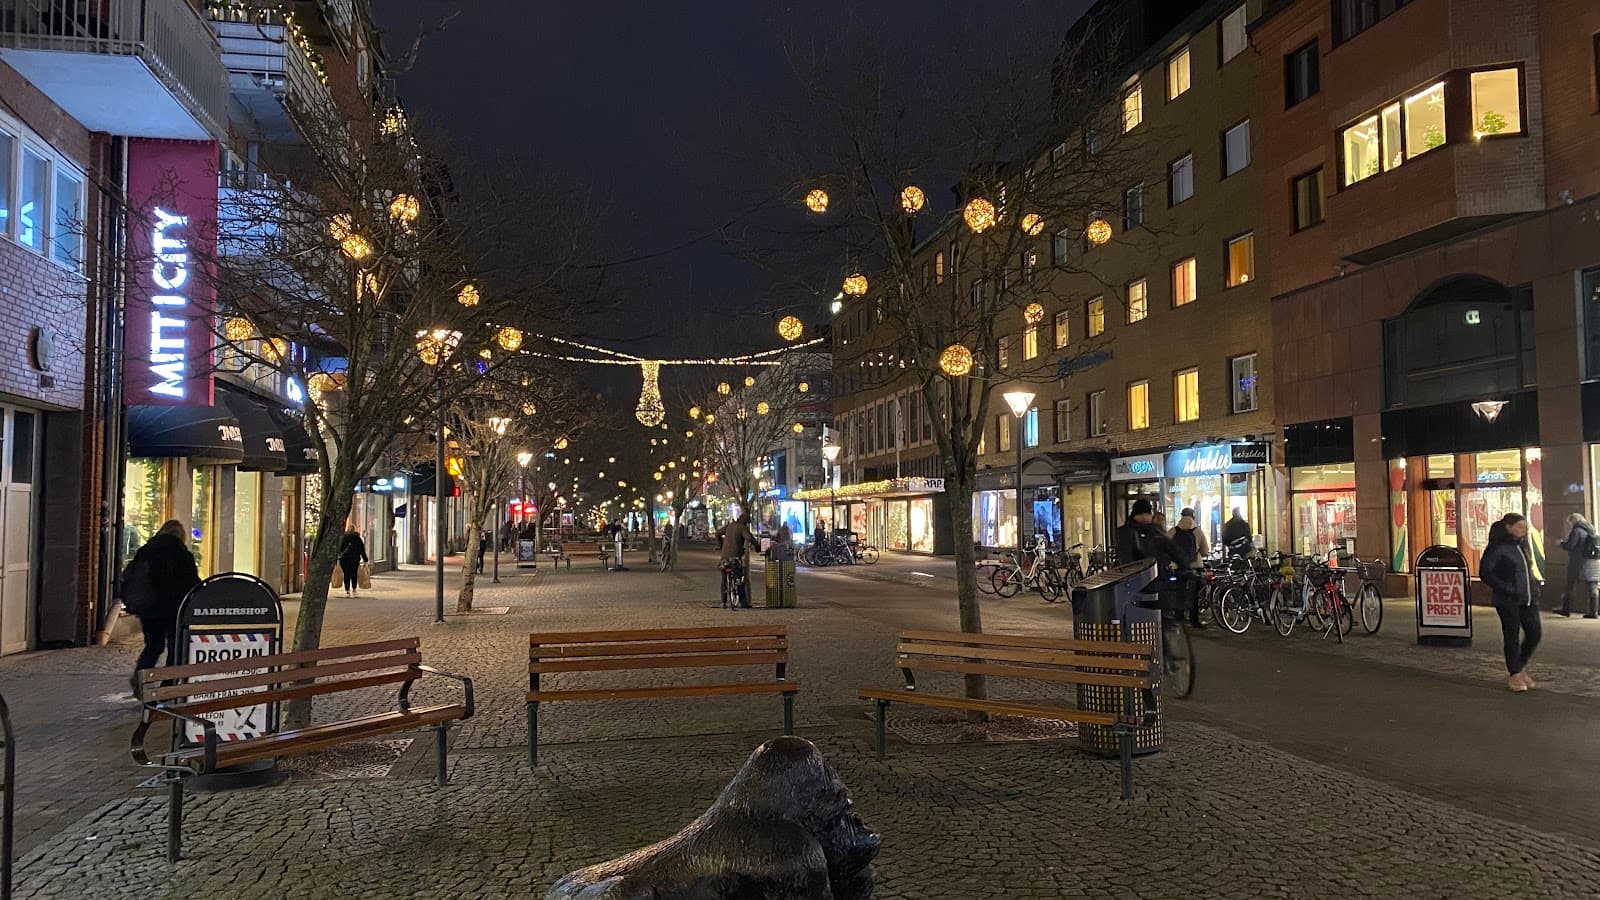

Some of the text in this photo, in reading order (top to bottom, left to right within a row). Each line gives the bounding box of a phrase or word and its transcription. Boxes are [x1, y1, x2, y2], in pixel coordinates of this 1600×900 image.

[148, 206, 188, 398] MITT I CITY
[1425, 572, 1462, 586] HALVA
[1426, 586, 1463, 604] REA
[193, 607, 269, 617] BARBERSHOP
[1426, 604, 1463, 616] PRISET
[195, 648, 263, 664] DROP IN
